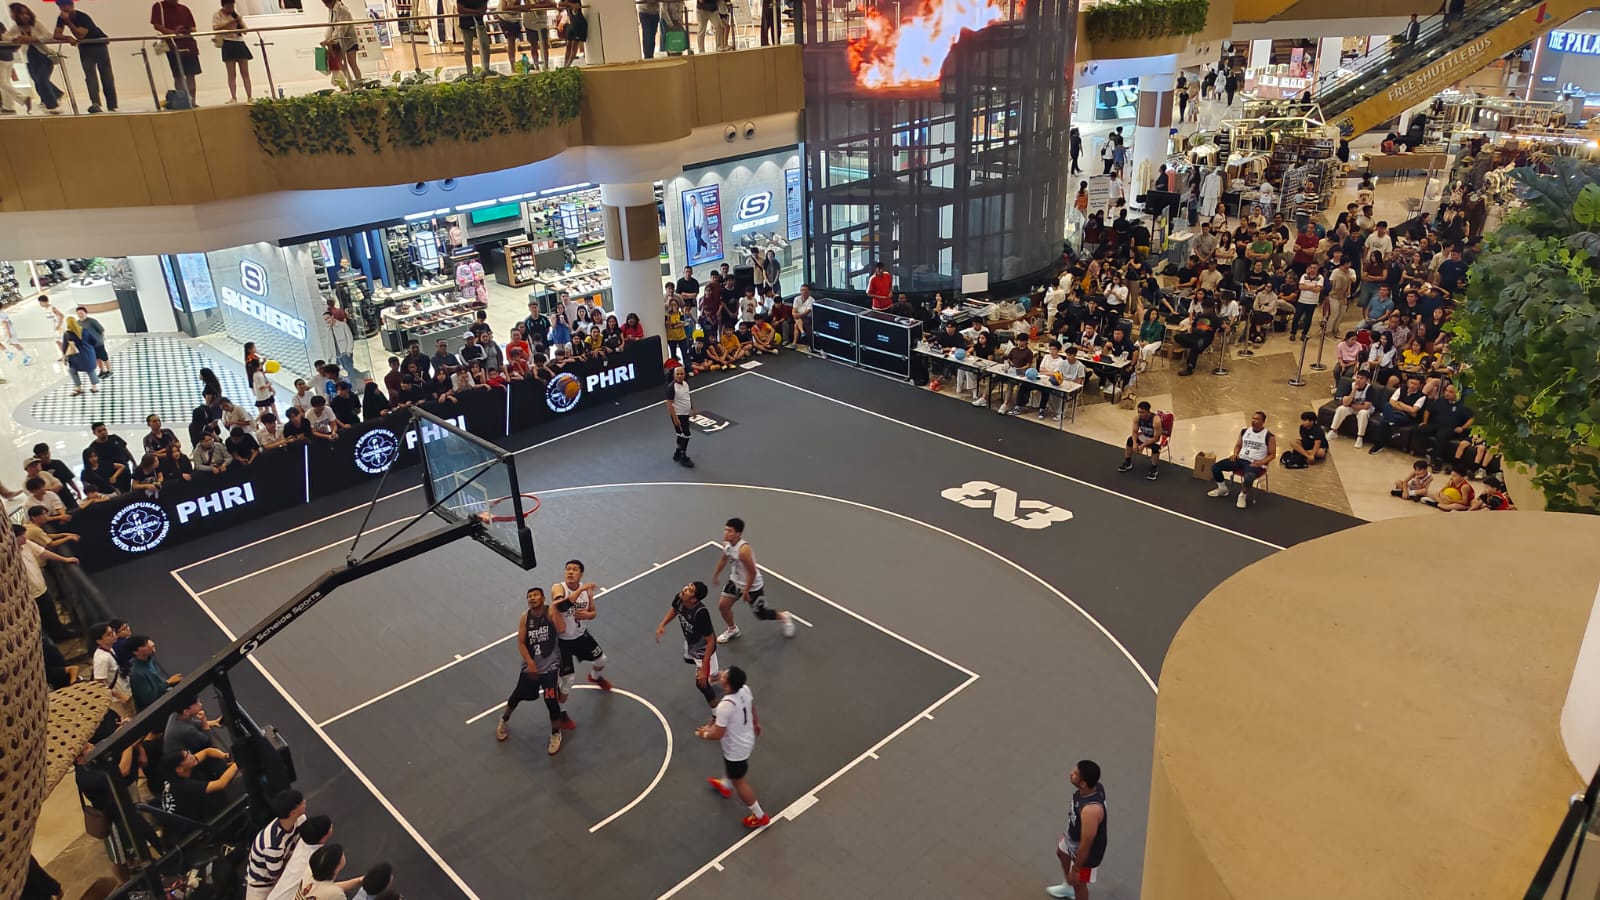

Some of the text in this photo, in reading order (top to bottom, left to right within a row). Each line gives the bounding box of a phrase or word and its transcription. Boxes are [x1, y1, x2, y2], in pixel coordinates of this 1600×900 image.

[1549, 31, 1566, 50] THE
[1388, 79, 1416, 101] FREE
[1417, 50, 1468, 84] SHUTTLE
[1468, 38, 1492, 58] BUS
[221, 286, 307, 341] SKECHERS
[585, 363, 635, 393] PHRI
[176, 482, 255, 524] PHRI
[291, 591, 321, 614] Sports
[743, 706, 748, 726] 1
